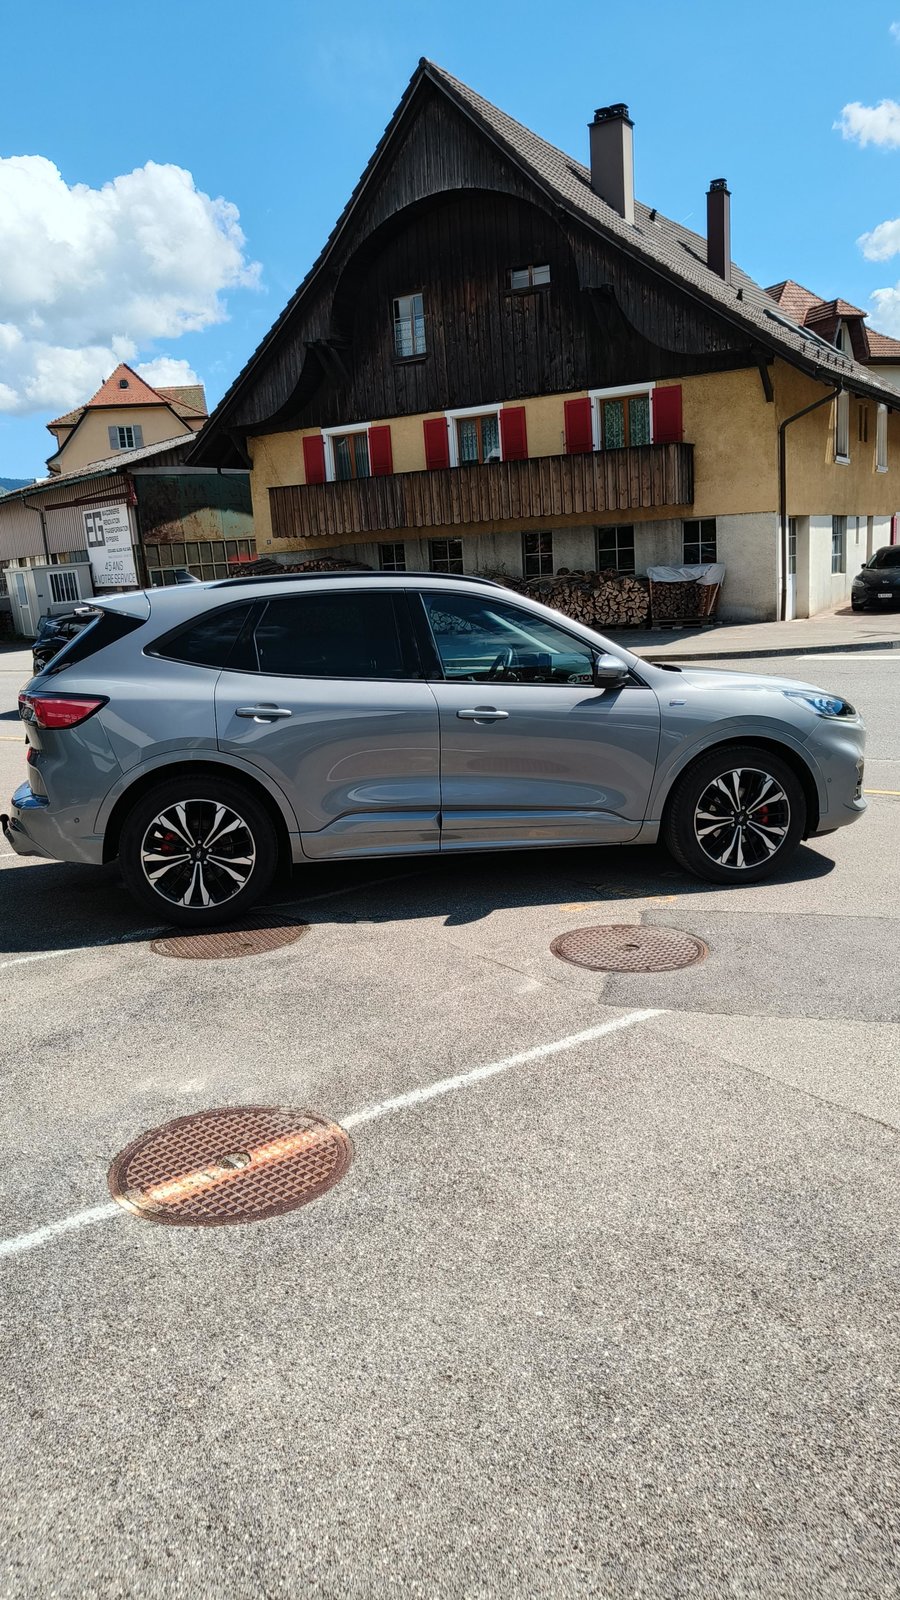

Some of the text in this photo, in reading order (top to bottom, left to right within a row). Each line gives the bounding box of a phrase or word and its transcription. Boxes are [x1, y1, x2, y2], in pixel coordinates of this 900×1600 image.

[84, 511, 106, 548] EG
[105, 560, 123, 572] 45 ANS
[98, 574, 114, 584] VOTRE
[114, 572, 136, 584] SERVICE
